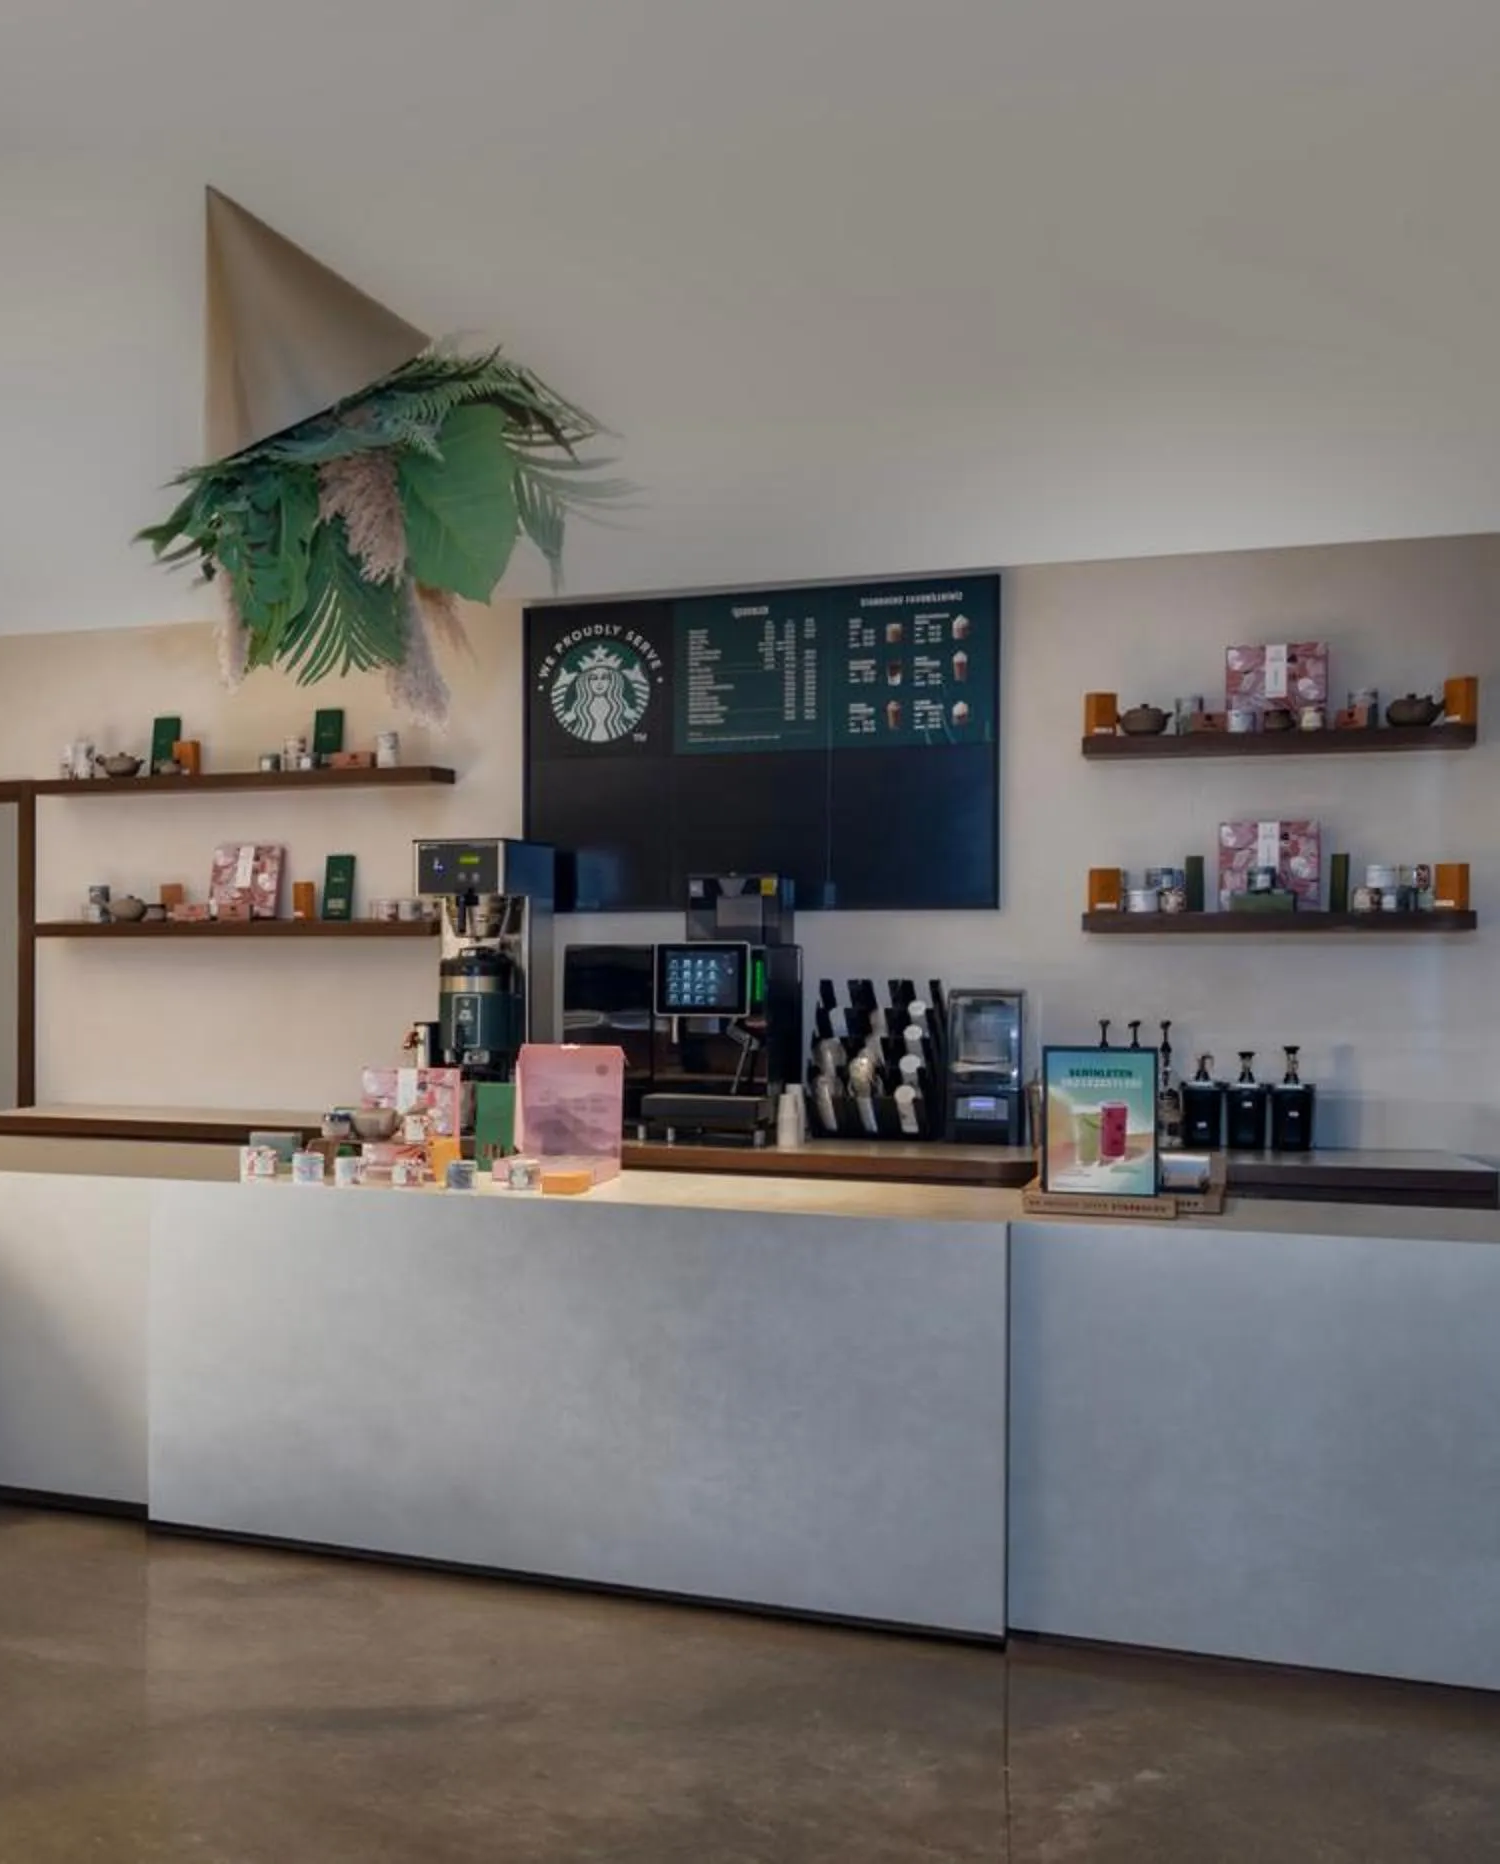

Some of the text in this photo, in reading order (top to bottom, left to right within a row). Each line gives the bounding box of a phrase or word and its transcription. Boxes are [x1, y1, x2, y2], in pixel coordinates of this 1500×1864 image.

[538, 624, 661, 677] WE PROUDLY SERVE
